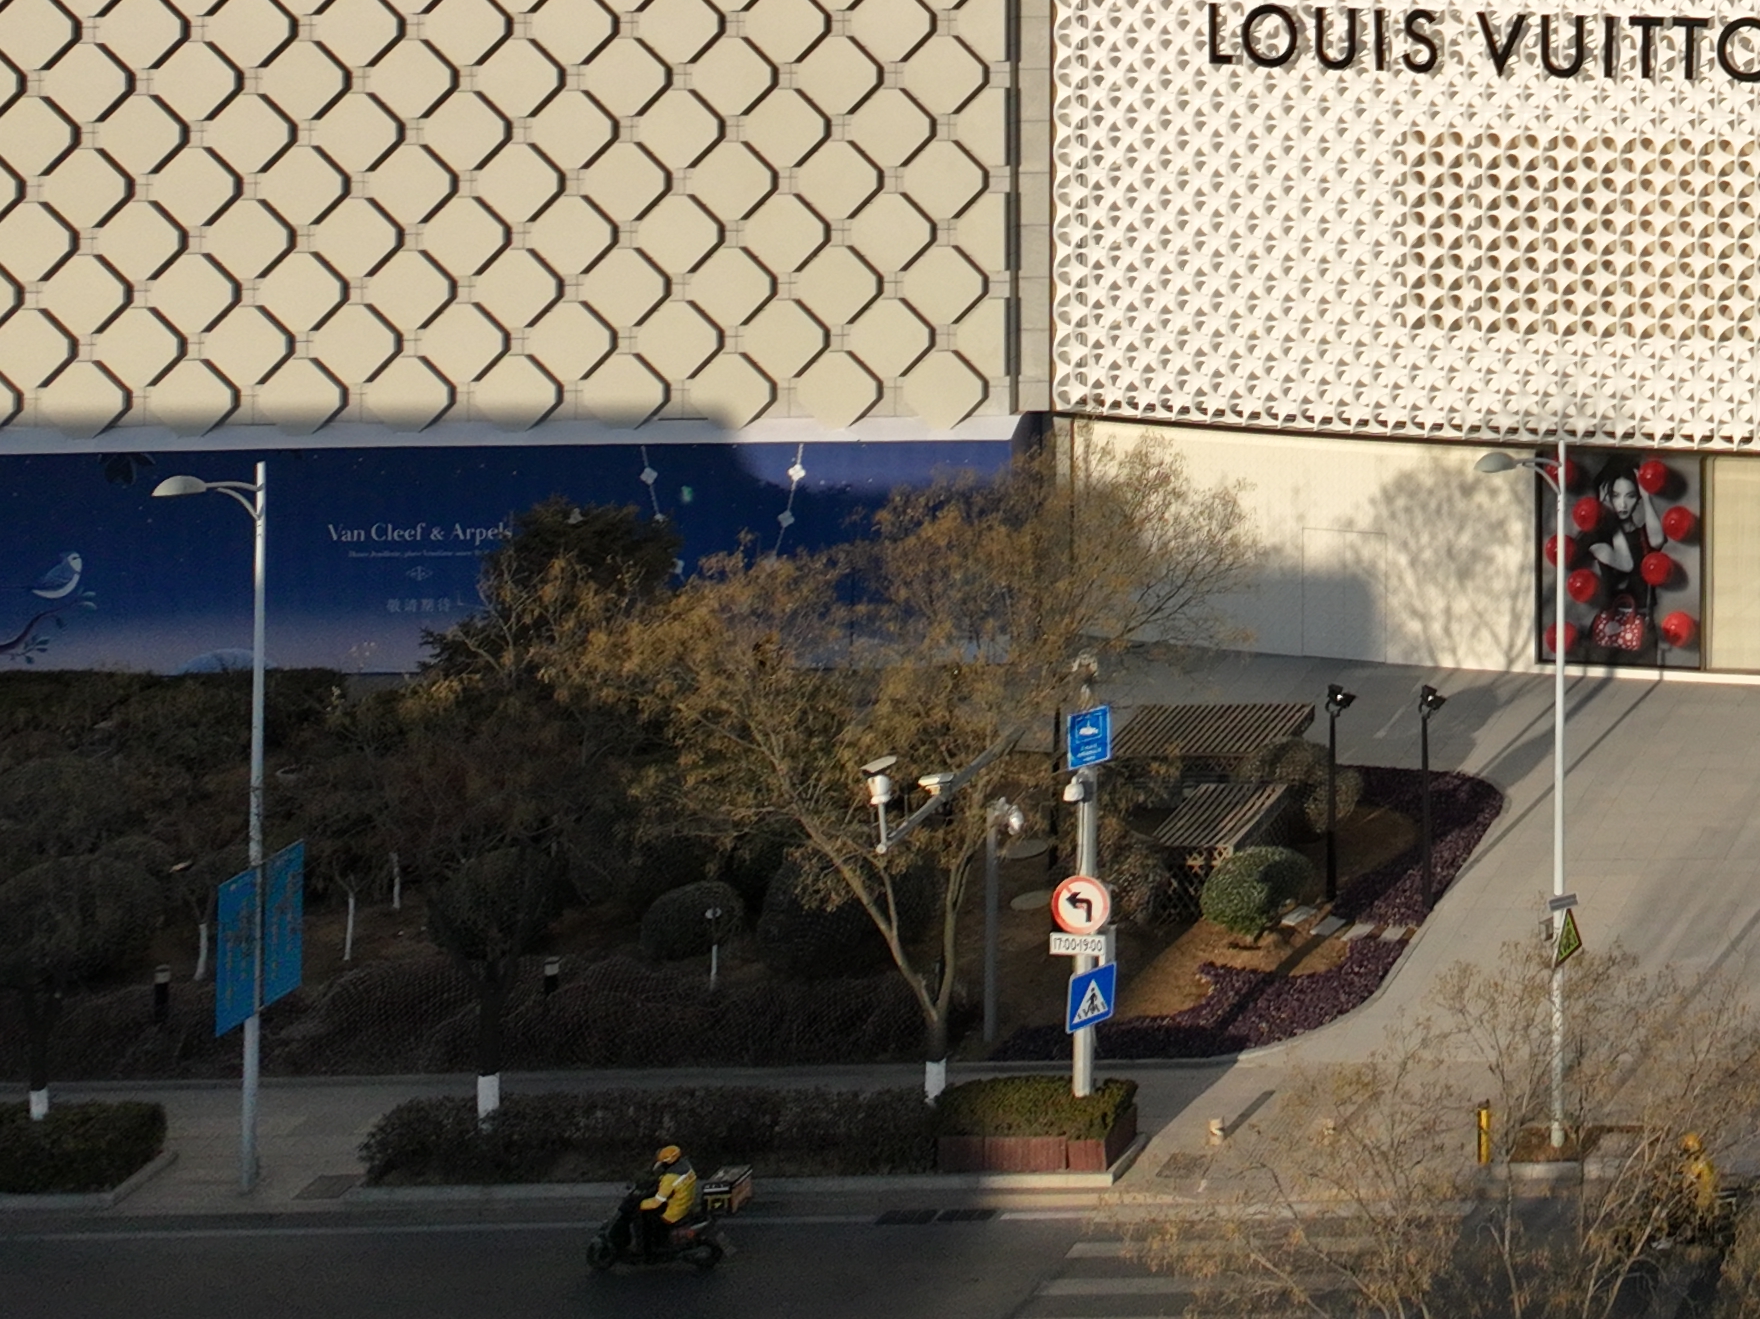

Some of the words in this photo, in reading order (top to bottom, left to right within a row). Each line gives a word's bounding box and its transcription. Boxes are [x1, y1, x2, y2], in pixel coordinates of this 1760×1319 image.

[1208, 2, 1438, 74] LOUIS
[328, 523, 366, 542] Van
[371, 522, 426, 542] Cleef
[430, 527, 445, 541] &
[449, 522, 512, 546] Arpels
[1053, 937, 1103, 952] 17:00-19:00
